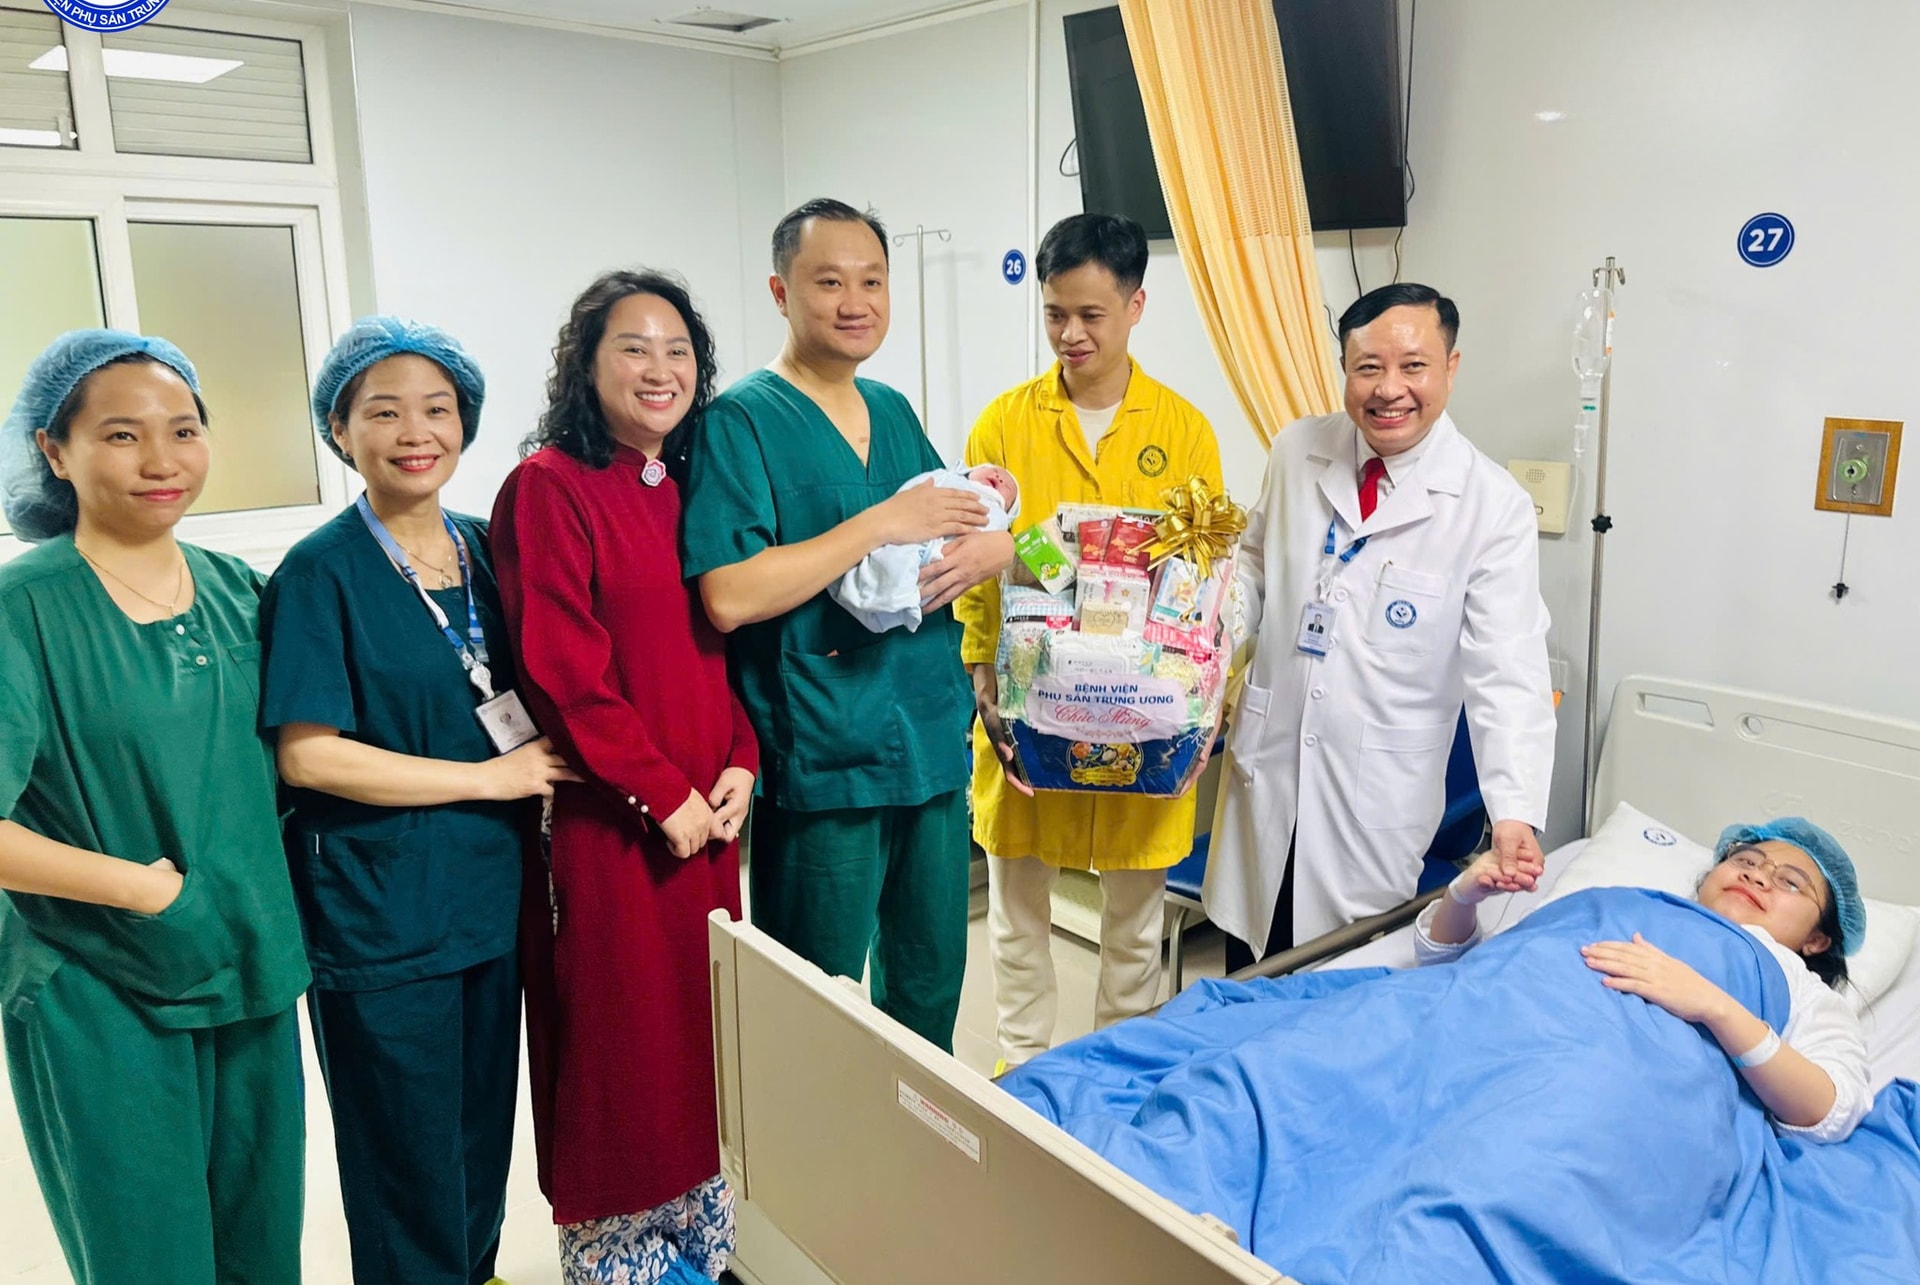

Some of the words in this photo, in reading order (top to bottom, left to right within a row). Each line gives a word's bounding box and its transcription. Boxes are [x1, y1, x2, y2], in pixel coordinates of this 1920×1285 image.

[1747, 227, 1784, 252] 27
[1006, 258, 1022, 275] 26
[1074, 682, 1107, 695] BỆNH
[1111, 682, 1138, 695] VIỆN
[1038, 689, 1062, 702] PHỤ
[1065, 692, 1091, 703] SẢN
[1095, 695, 1136, 705] TRUNG
